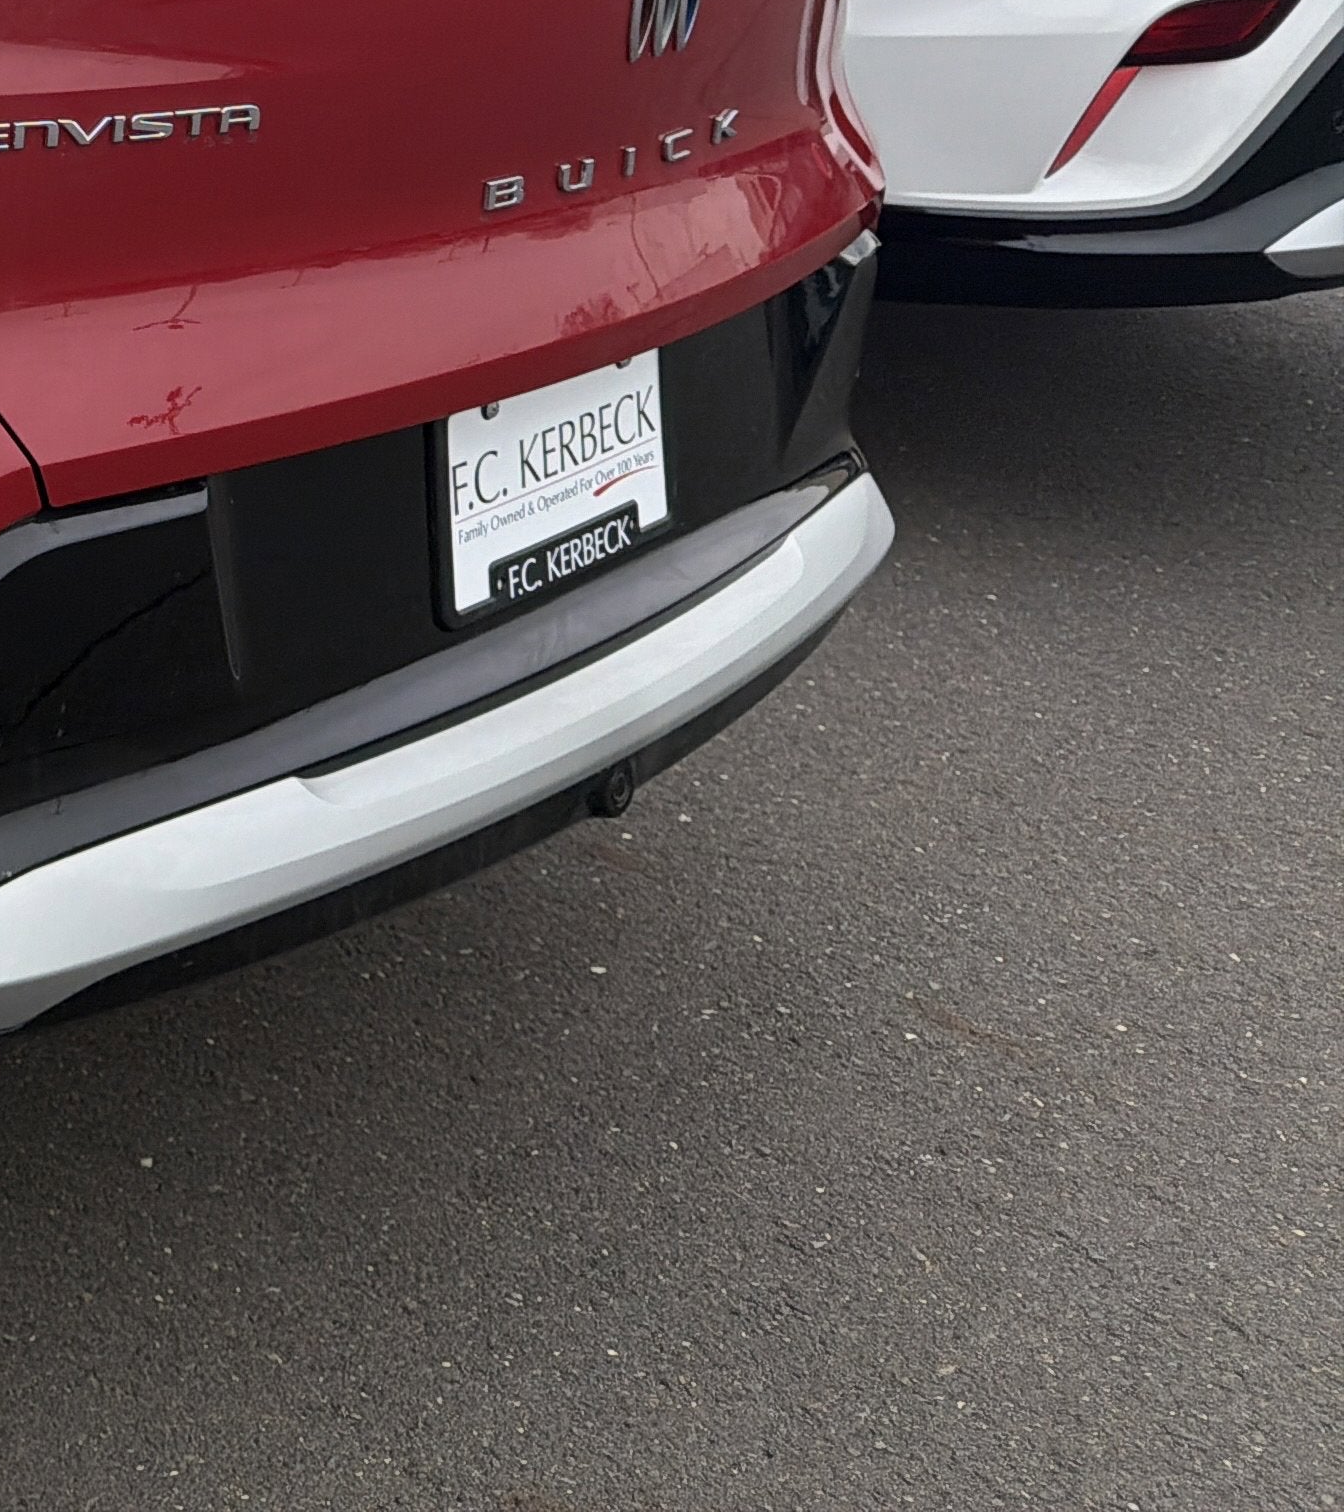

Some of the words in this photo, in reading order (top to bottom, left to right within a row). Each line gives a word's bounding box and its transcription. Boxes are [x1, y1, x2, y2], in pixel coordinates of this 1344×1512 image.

[483, 108, 739, 211] BUICK
[451, 450, 508, 516] F.C.
[518, 385, 657, 489] KERBECK
[457, 520, 489, 546] Family
[491, 504, 526, 531] Owned
[527, 502, 536, 517] &
[537, 484, 579, 511] Operated
[580, 476, 594, 494] For
[595, 467, 615, 486] Over
[617, 458, 632, 475] 100
[633, 449, 655, 468] Years
[507, 558, 543, 599] F.C.
[546, 515, 632, 579] KERBECK
